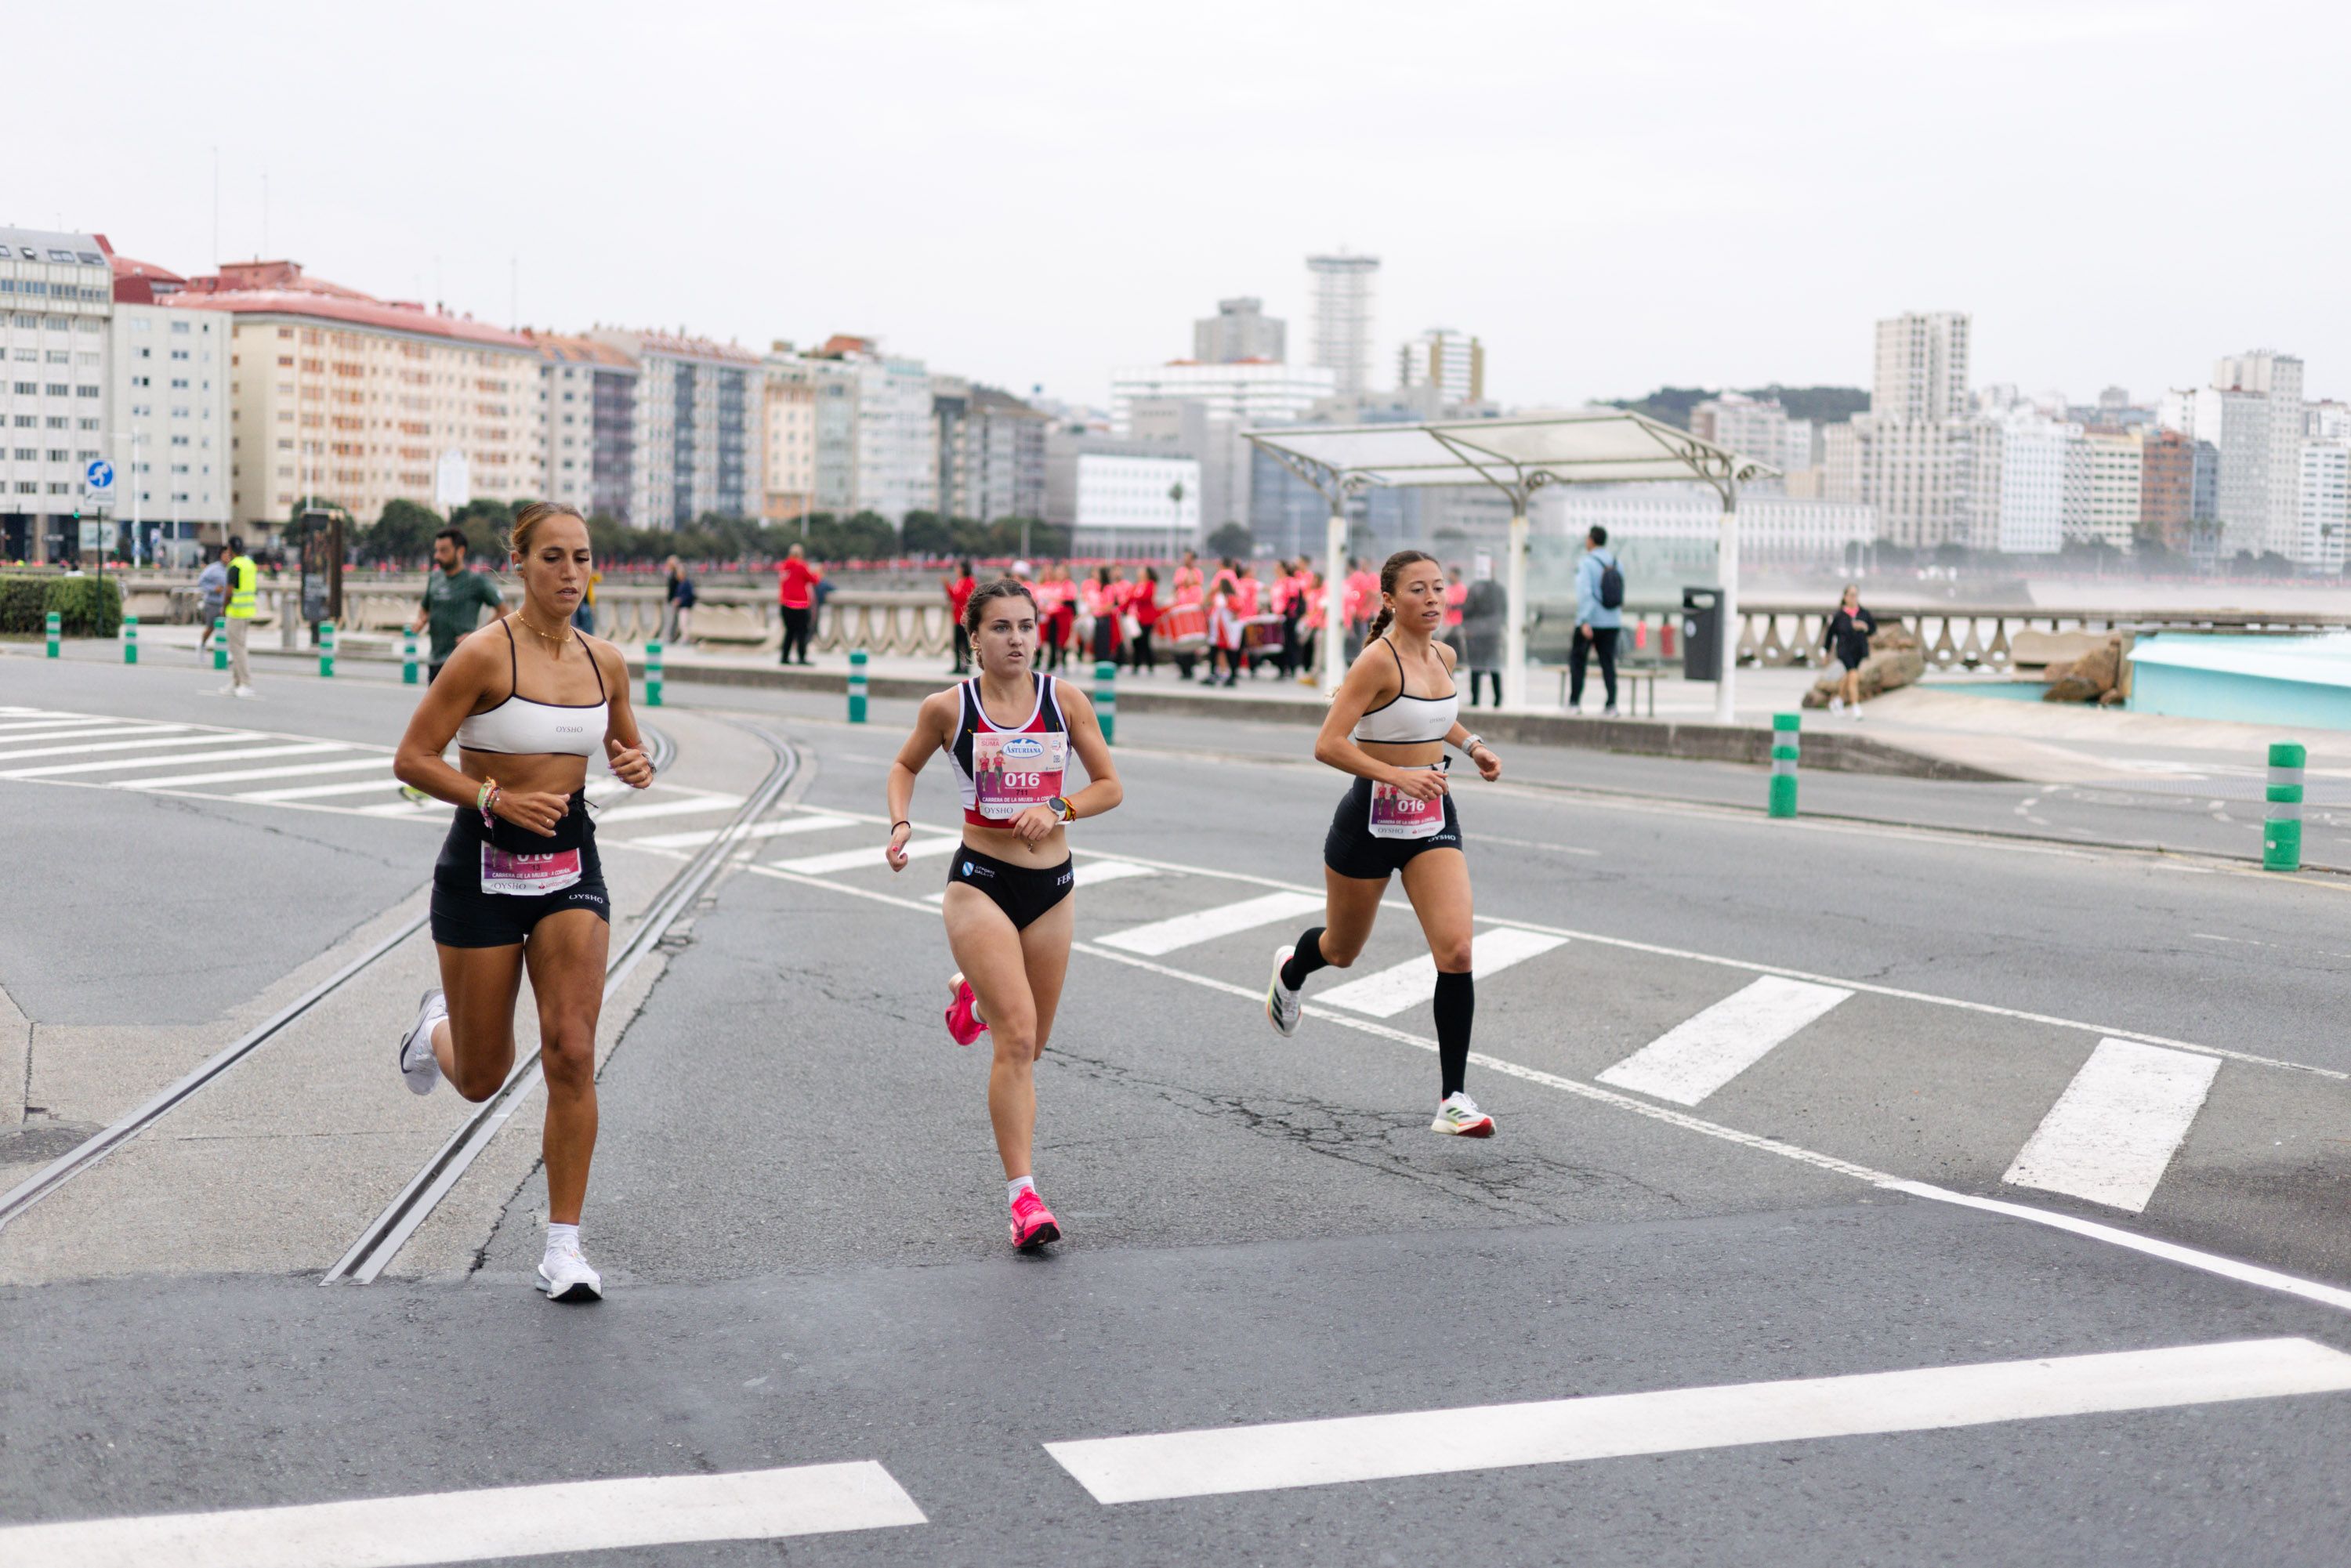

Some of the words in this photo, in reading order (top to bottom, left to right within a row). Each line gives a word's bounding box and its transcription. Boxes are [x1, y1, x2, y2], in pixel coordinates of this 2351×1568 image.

[1005, 773, 1040, 787] 016
[1398, 800, 1425, 812] 016
[1428, 834, 1456, 842] OYSHO
[568, 893, 603, 904] OYSHO
